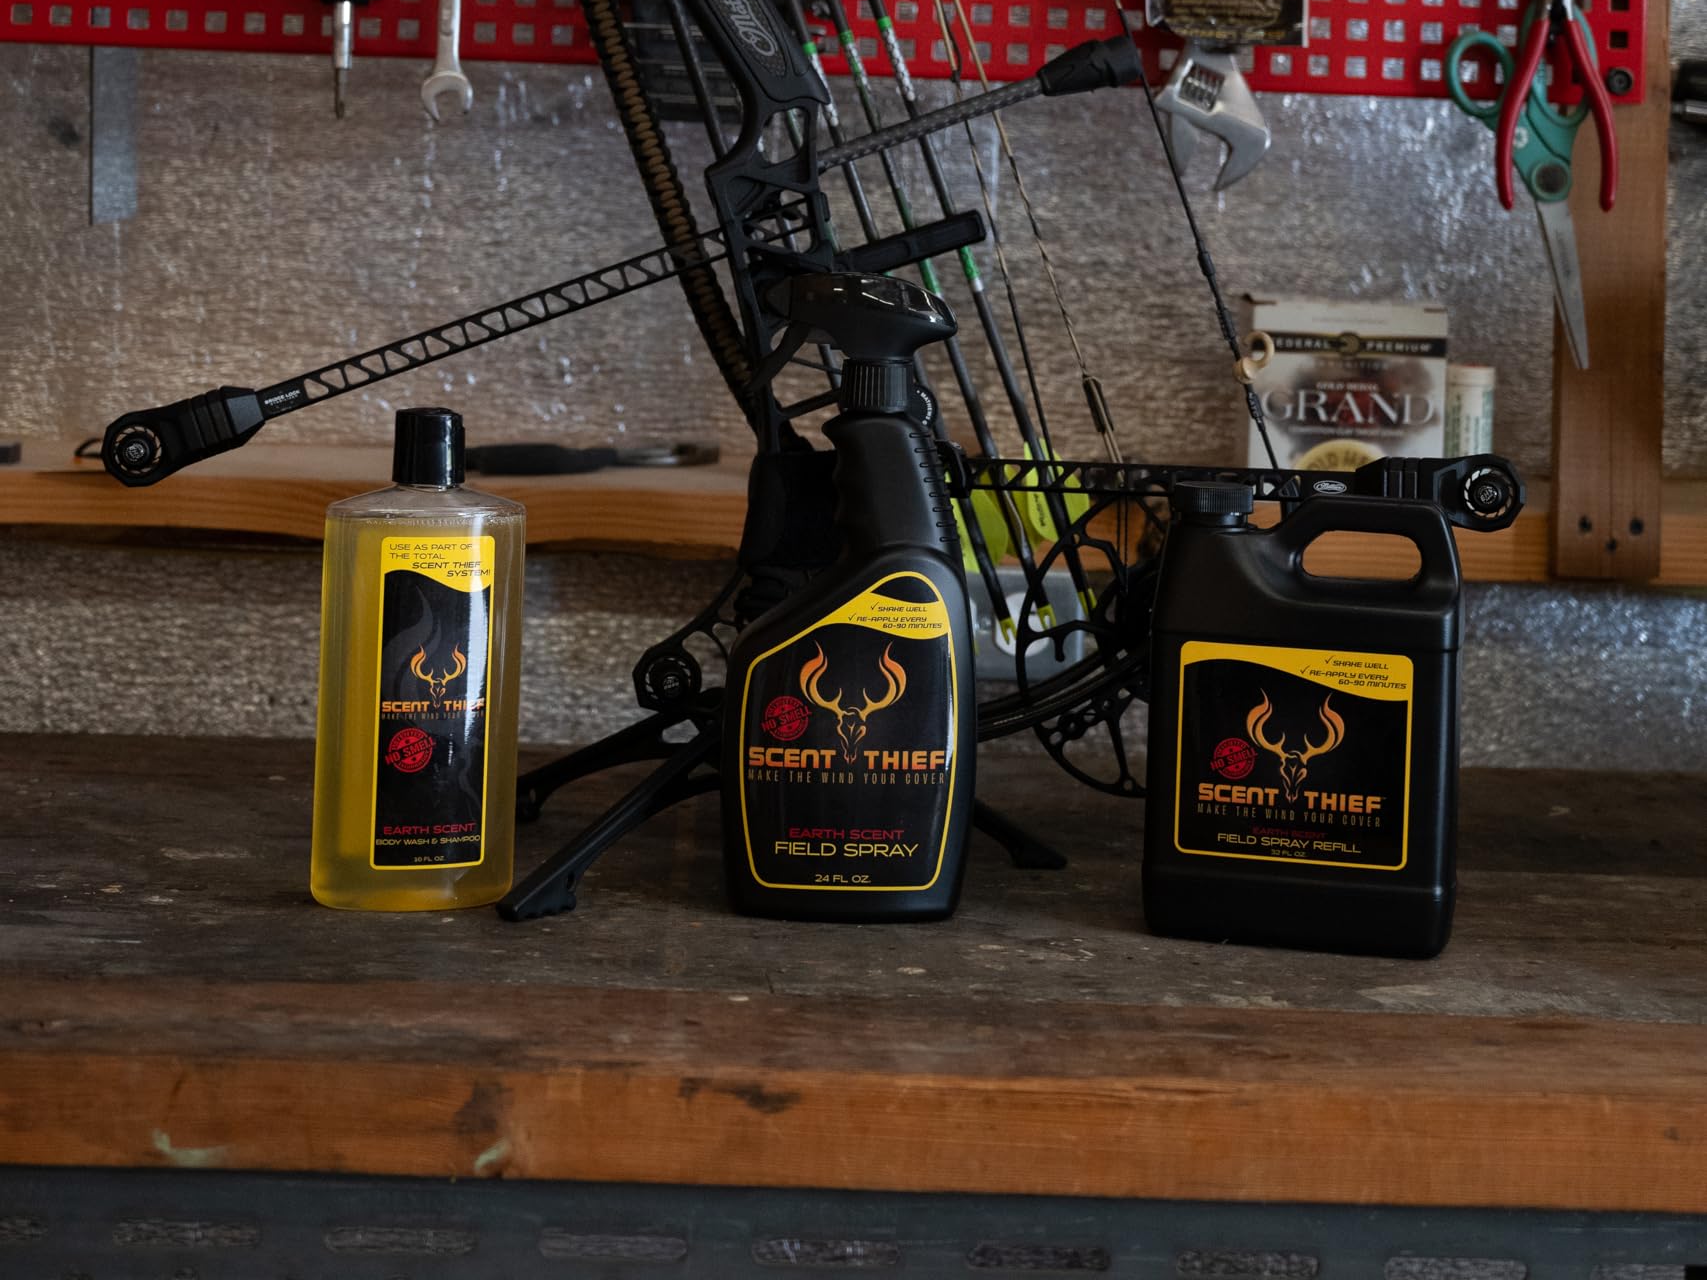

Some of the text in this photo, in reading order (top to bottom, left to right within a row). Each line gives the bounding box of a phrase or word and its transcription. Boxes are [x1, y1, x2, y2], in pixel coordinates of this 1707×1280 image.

[1275, 337, 1432, 353] EDERAL PREMIUM
[1261, 389, 1435, 425] GRAND
[389, 543, 411, 551] USE
[413, 543, 428, 551] AS
[431, 543, 457, 551] PART
[389, 552, 446, 560] THE TOTAL
[412, 560, 481, 569] SCENT THIEF
[446, 569, 491, 577] SYSTEM!
[1332, 660, 1389, 670] SHAKE WELL
[1309, 669, 1389, 681] RE-APPLY EVERY
[1338, 678, 1407, 690] 60-90 MINUTES
[381, 701, 430, 713] SCENT
[760, 719, 777, 732] NO
[779, 705, 813, 725] SMELL
[386, 751, 401, 766] NO
[402, 736, 437, 757] SMELL
[748, 746, 946, 770] SCENT THIEF
[1209, 758, 1225, 771] NO
[1226, 747, 1259, 765] SMELL
[748, 769, 945, 785] MAKE THE WIND YOUR COVER
[1198, 782, 1383, 814] SCENT THIEF
[1197, 803, 1382, 828] MAKE THE WIND YOUR COVER
[383, 822, 476, 835] EARTH SCENT
[789, 828, 905, 840] EARTH SCENT
[1252, 826, 1328, 839] EARTH SCENT
[375, 838, 402, 846] BODY
[403, 838, 430, 846] WASH
[440, 834, 481, 845] SHAMPOO
[1217, 832, 1362, 854] FIELD SPRAY REFILL
[775, 841, 919, 858] FIELD SPRAY
[815, 874, 830, 883] 24
[832, 874, 849, 883] FL
